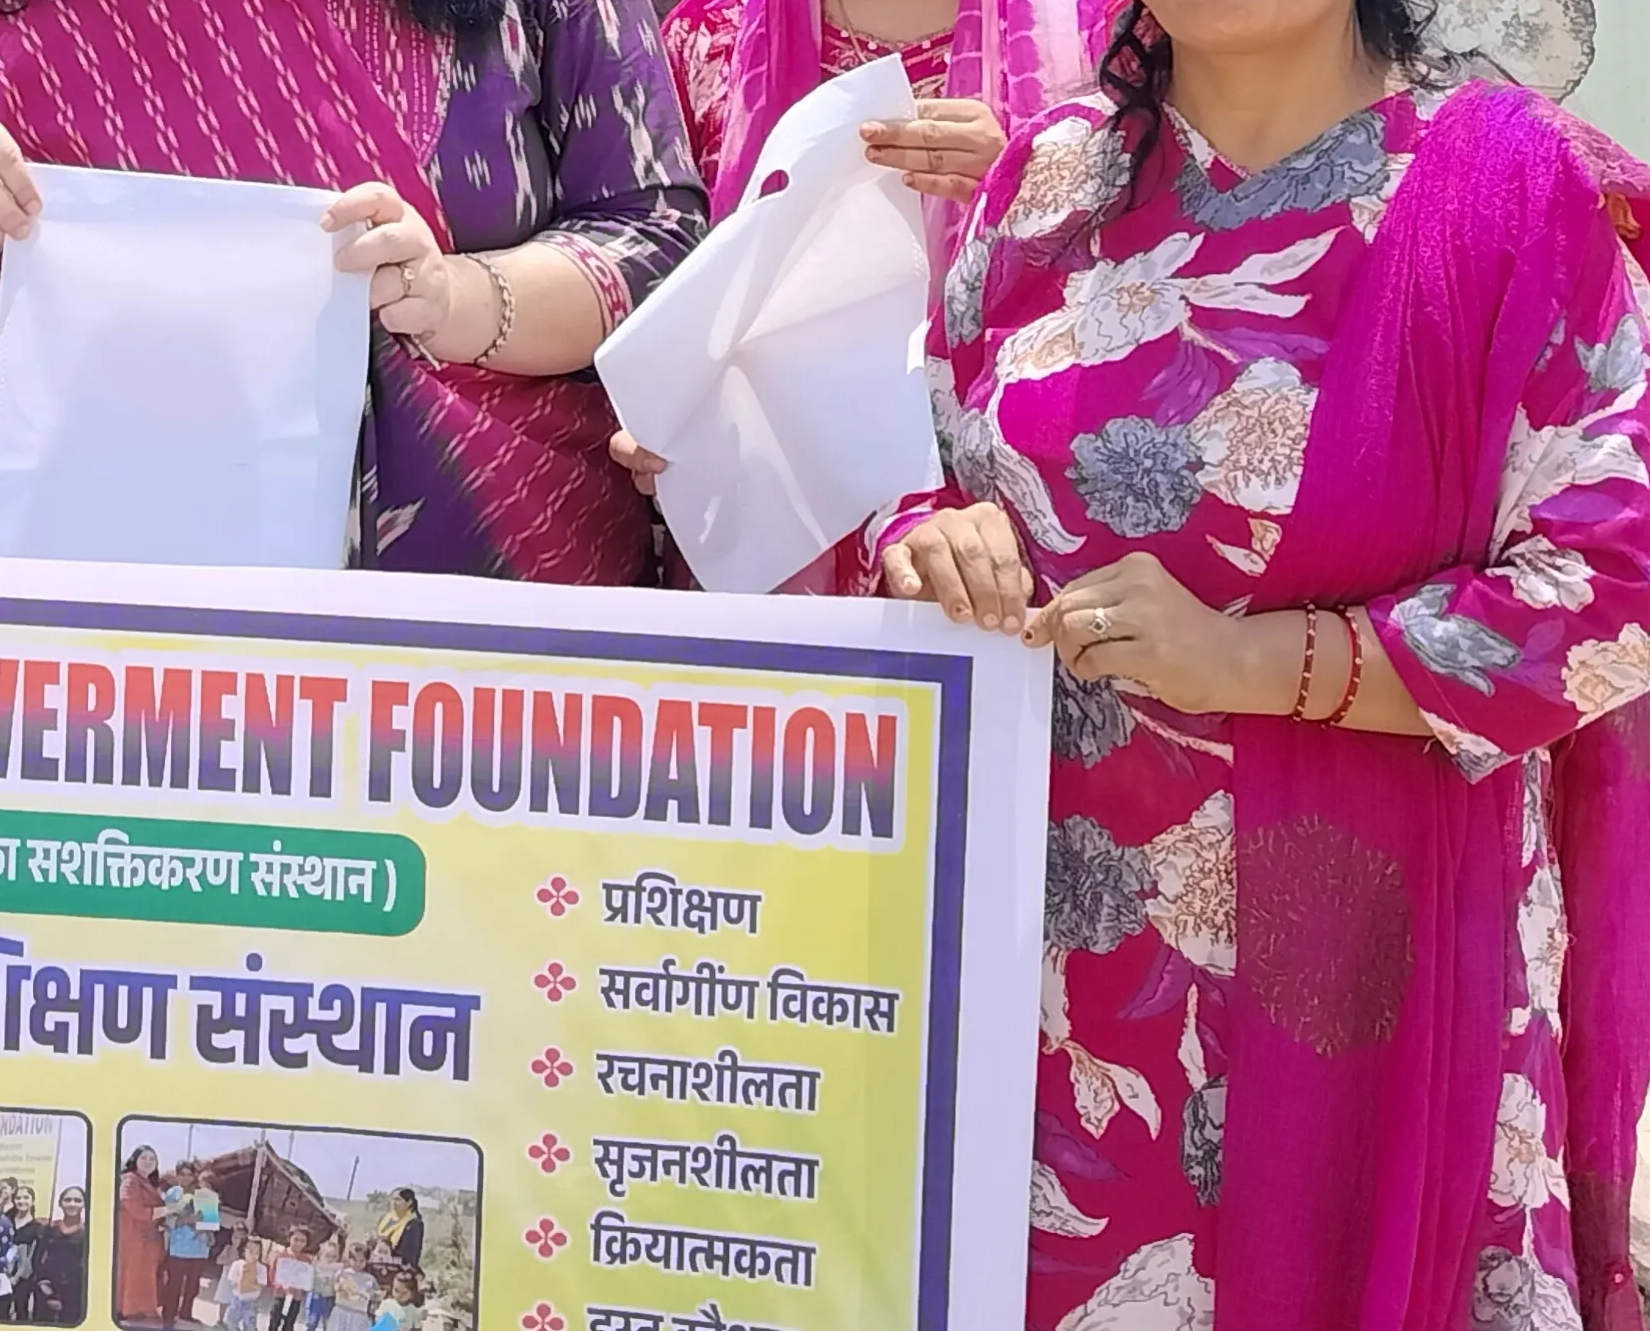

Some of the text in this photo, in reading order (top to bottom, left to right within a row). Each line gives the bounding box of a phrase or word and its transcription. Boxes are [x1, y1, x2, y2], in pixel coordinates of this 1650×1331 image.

[368, 678, 898, 840] FOUNDATION
[27, 828, 243, 895] सशक्तिकरण
[249, 840, 376, 903] संस्थान
[601, 871, 762, 935] प्रशिक्षण
[189, 952, 481, 1082] संस्थान
[766, 968, 900, 1033] विकास
[595, 1049, 821, 1112] रचनाशीलता
[592, 1134, 820, 1200] सृजनशीलता
[590, 1211, 816, 1287] क्रियात्मकता
